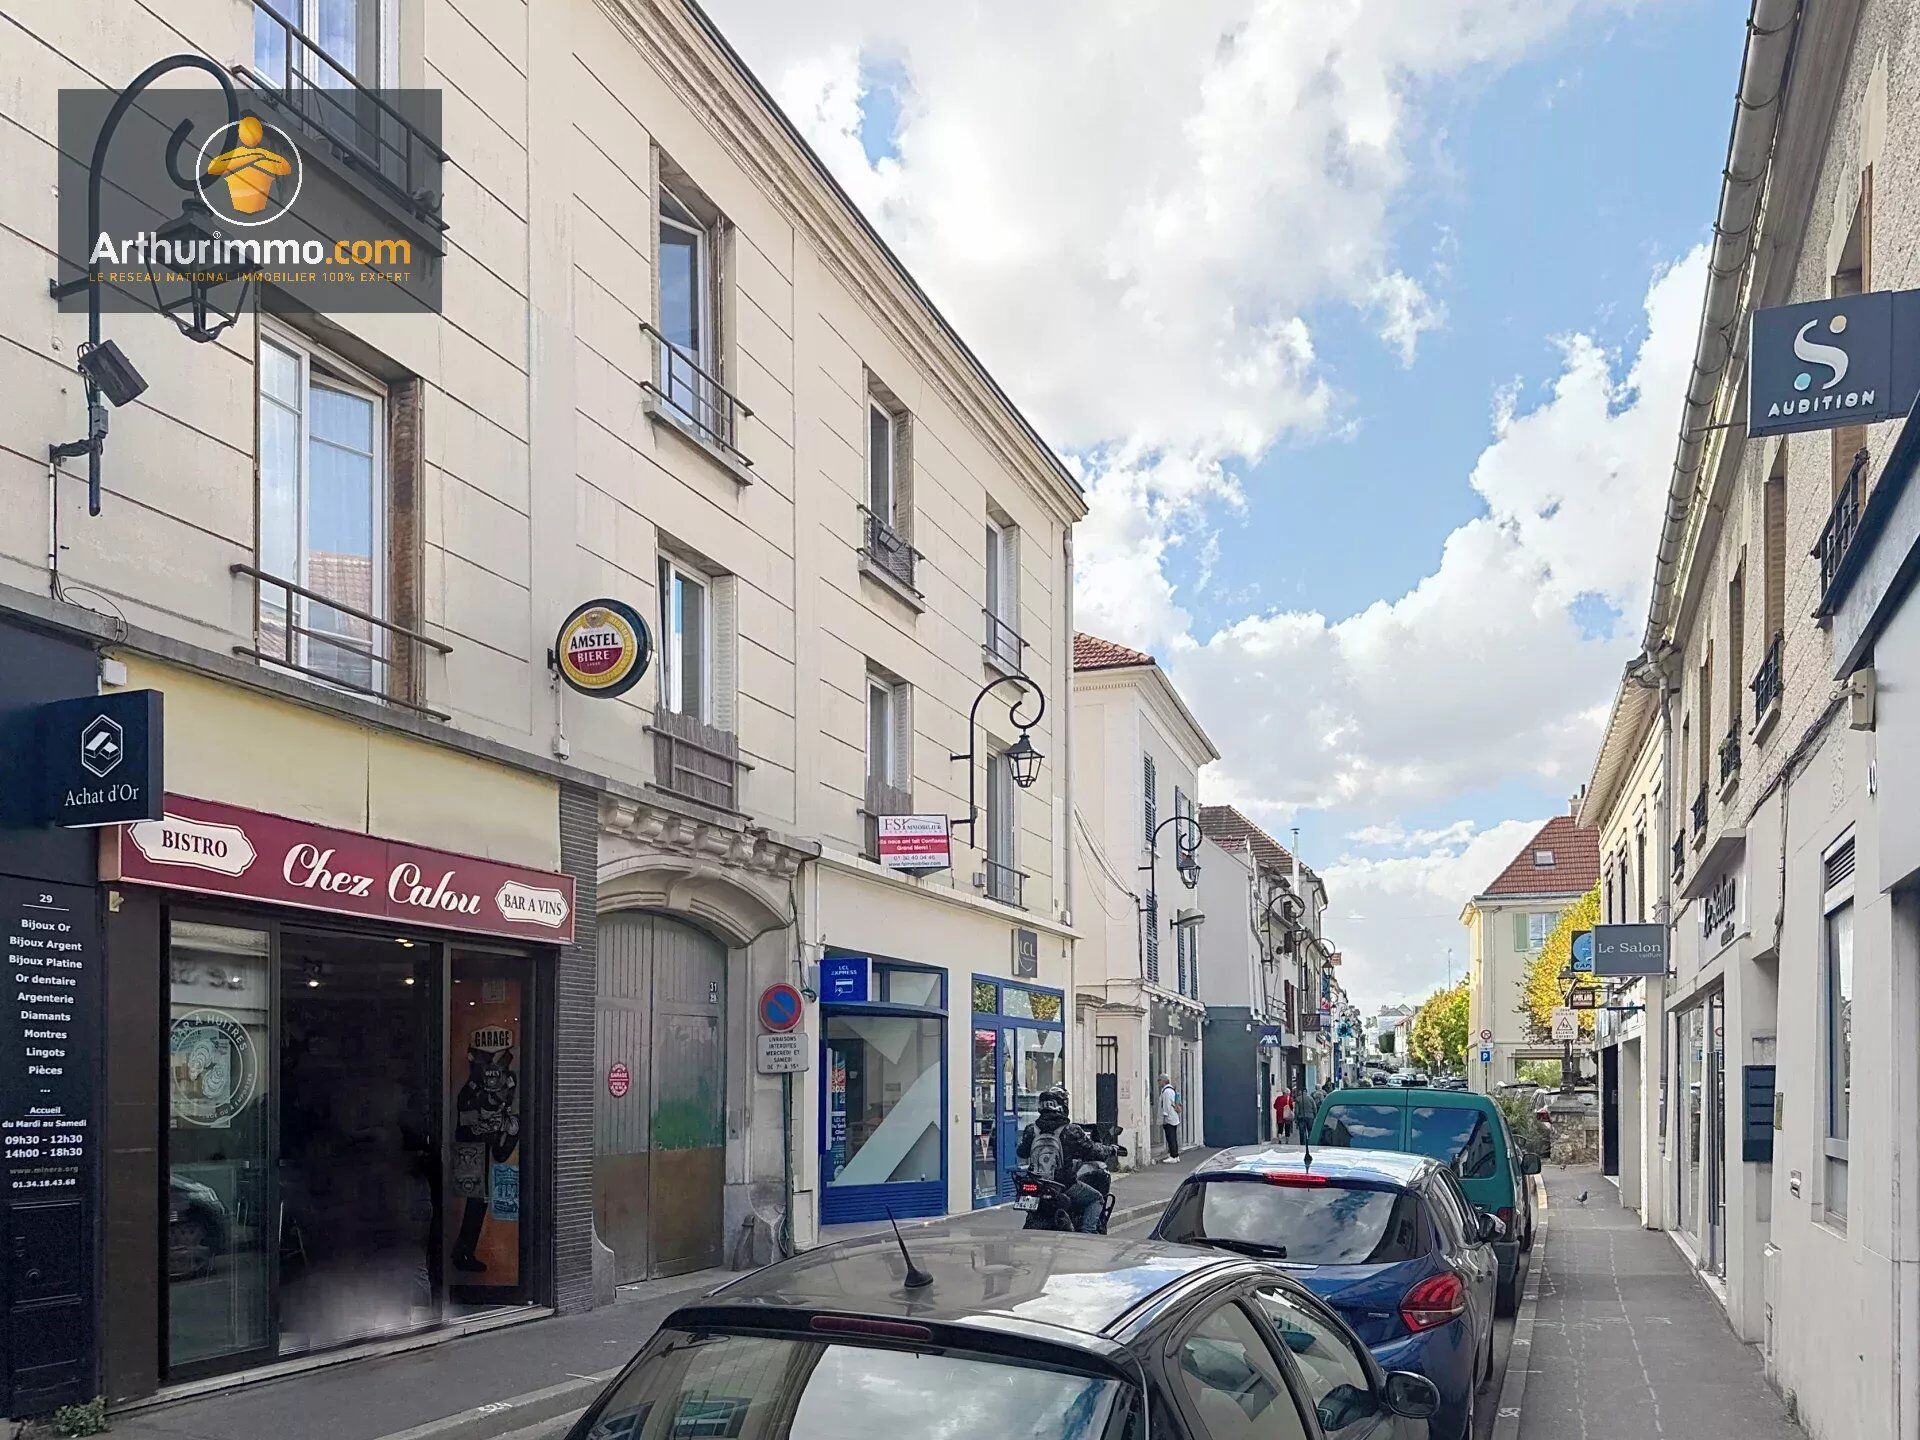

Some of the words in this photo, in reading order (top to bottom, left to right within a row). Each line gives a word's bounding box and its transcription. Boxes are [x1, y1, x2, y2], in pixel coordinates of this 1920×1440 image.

[1768, 390, 1875, 418] AUDITION
[570, 633, 618, 650] AMSTEL
[578, 650, 610, 662] BIERE
[64, 789, 104, 806] Achat
[108, 784, 139, 802] d'Or
[162, 830, 228, 858] BISTRO
[283, 843, 374, 897] Chez
[388, 862, 480, 915] Calou
[40, 894, 52, 904] 29
[504, 894, 526, 910] BAR
[528, 898, 536, 912] A
[538, 900, 562, 916] VINS
[21, 920, 55, 931] Bijoux
[58, 924, 71, 932] Or
[10, 936, 44, 948] Bijoux
[46, 940, 82, 952] Argent
[1020, 940, 1036, 958] LCL
[1598, 944, 1614, 953] Le
[1620, 942, 1662, 952] Salon
[9, 955, 43, 966] Bijoux
[46, 958, 82, 968] Platine
[16, 974, 29, 982] Or
[32, 975, 76, 986] dentaire
[710, 982, 717, 992] 31
[18, 992, 74, 1004] Argenterie
[20, 1011, 71, 1021] Diamants
[24, 1030, 67, 1039] Montres
[172, 1022, 193, 1045] BAR
[475, 1031, 510, 1048] GARAGE
[1260, 1034, 1278, 1044] AXA
[26, 1048, 66, 1058] Lingots
[28, 1066, 62, 1075] Pièces
[5, 1136, 40, 1144] 09h30
[51, 1134, 82, 1144] 12h30
[5, 1149, 40, 1158] 14h00
[50, 1148, 82, 1156] 18h30
